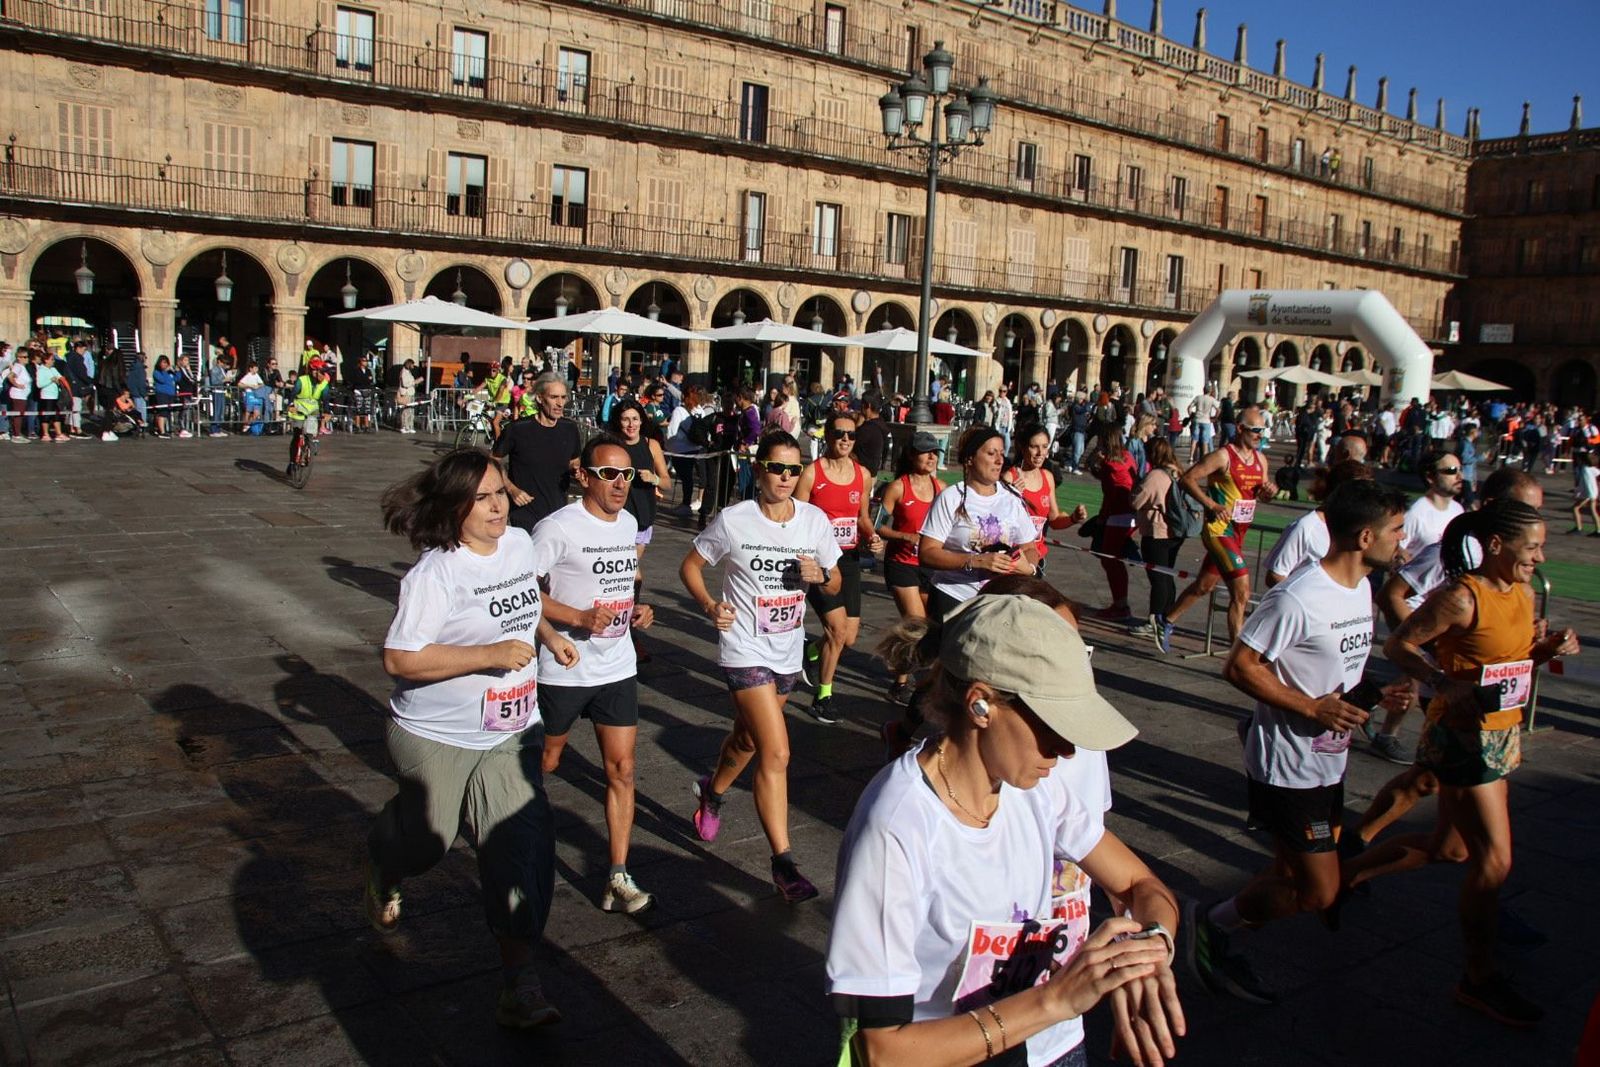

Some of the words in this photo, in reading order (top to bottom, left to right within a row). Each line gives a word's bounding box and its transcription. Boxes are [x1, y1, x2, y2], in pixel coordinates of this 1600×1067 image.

[1271, 303, 1332, 316] Ayuntamiento
[1284, 316, 1333, 325] Salamanca
[833, 527, 852, 537] 338
[489, 589, 540, 618] ÓSCAR
[500, 610, 538, 629] Corremos
[770, 606, 796, 622] 257
[1484, 664, 1531, 678] bedunia
[486, 679, 536, 702] bedunia
[500, 695, 529, 719] 511
